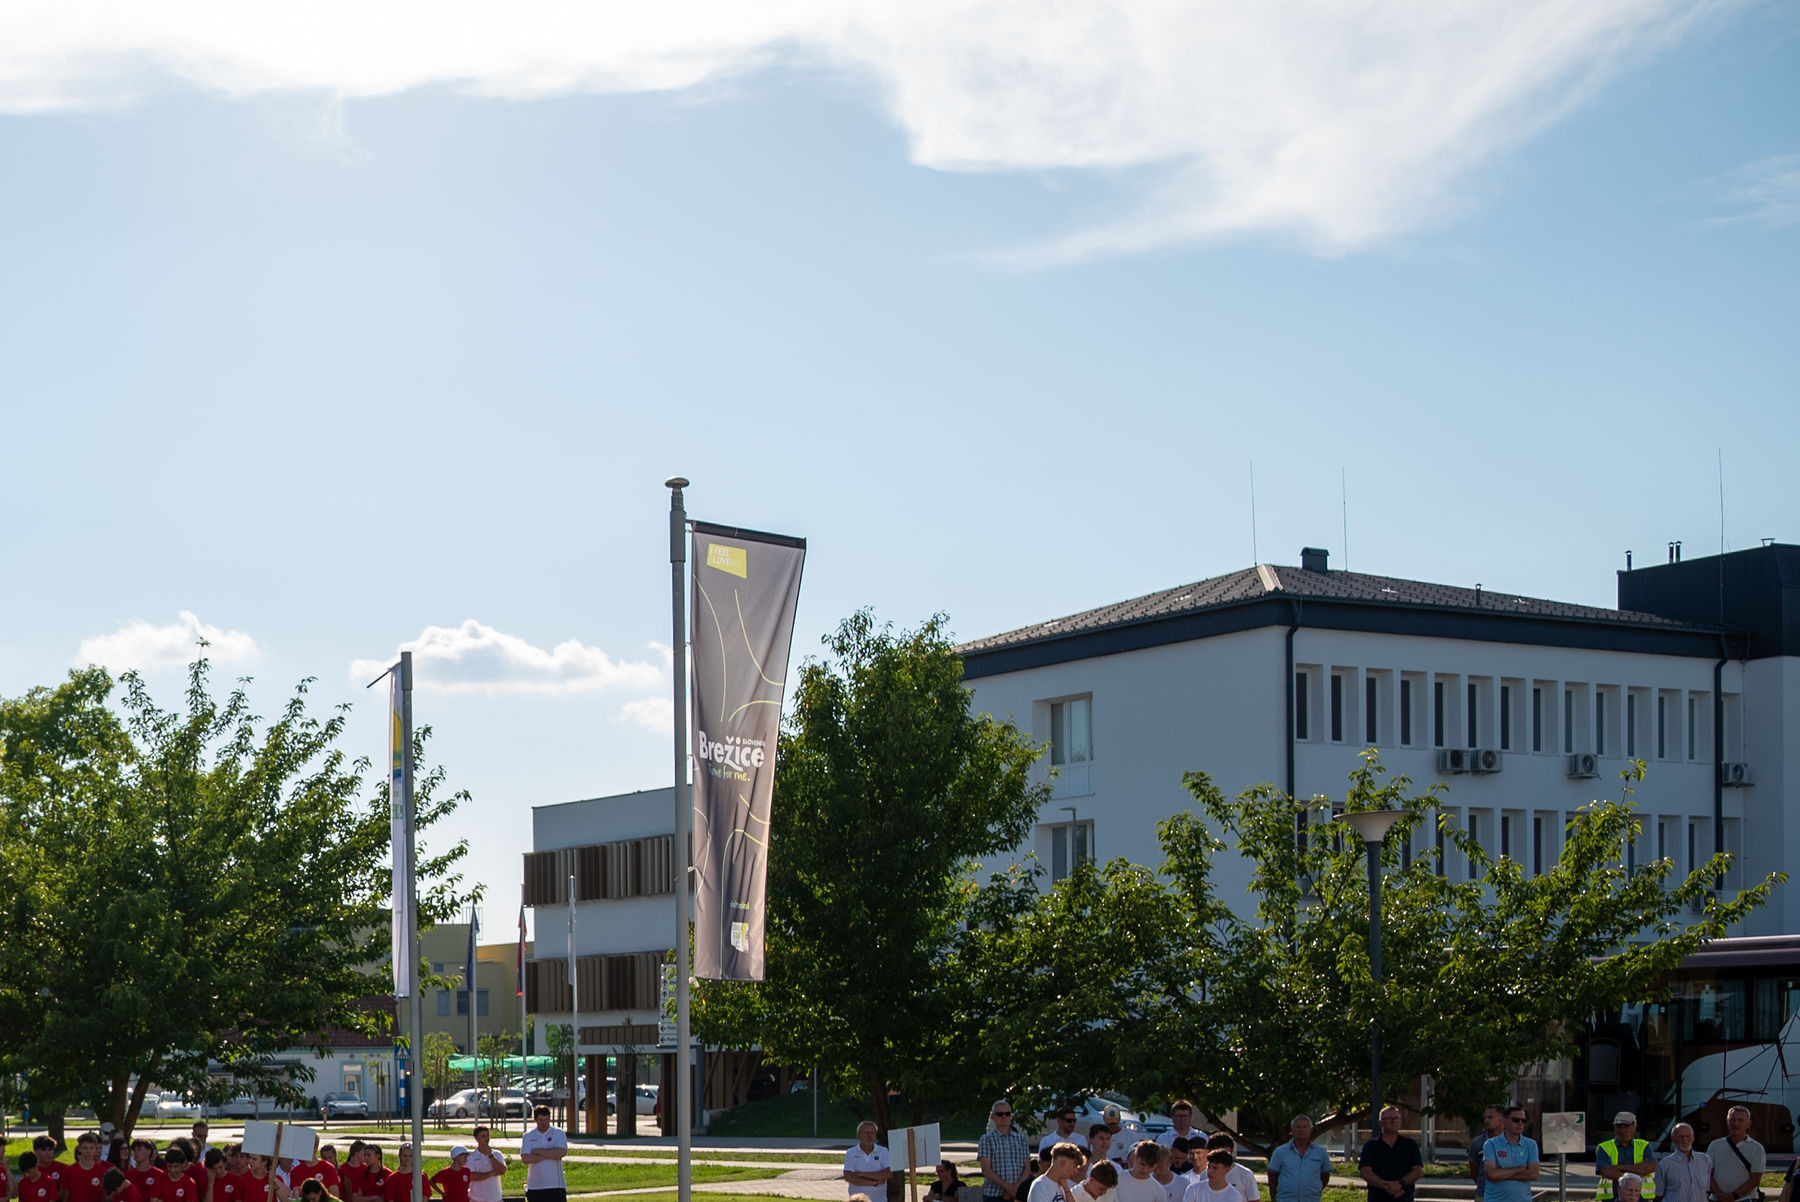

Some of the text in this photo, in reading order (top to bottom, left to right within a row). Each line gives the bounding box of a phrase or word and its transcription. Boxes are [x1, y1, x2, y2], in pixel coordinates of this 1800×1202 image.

[714, 544, 729, 556] FEEL
[698, 730, 765, 772] Brežice
[723, 765, 733, 780] for
[734, 772, 751, 782] me.
